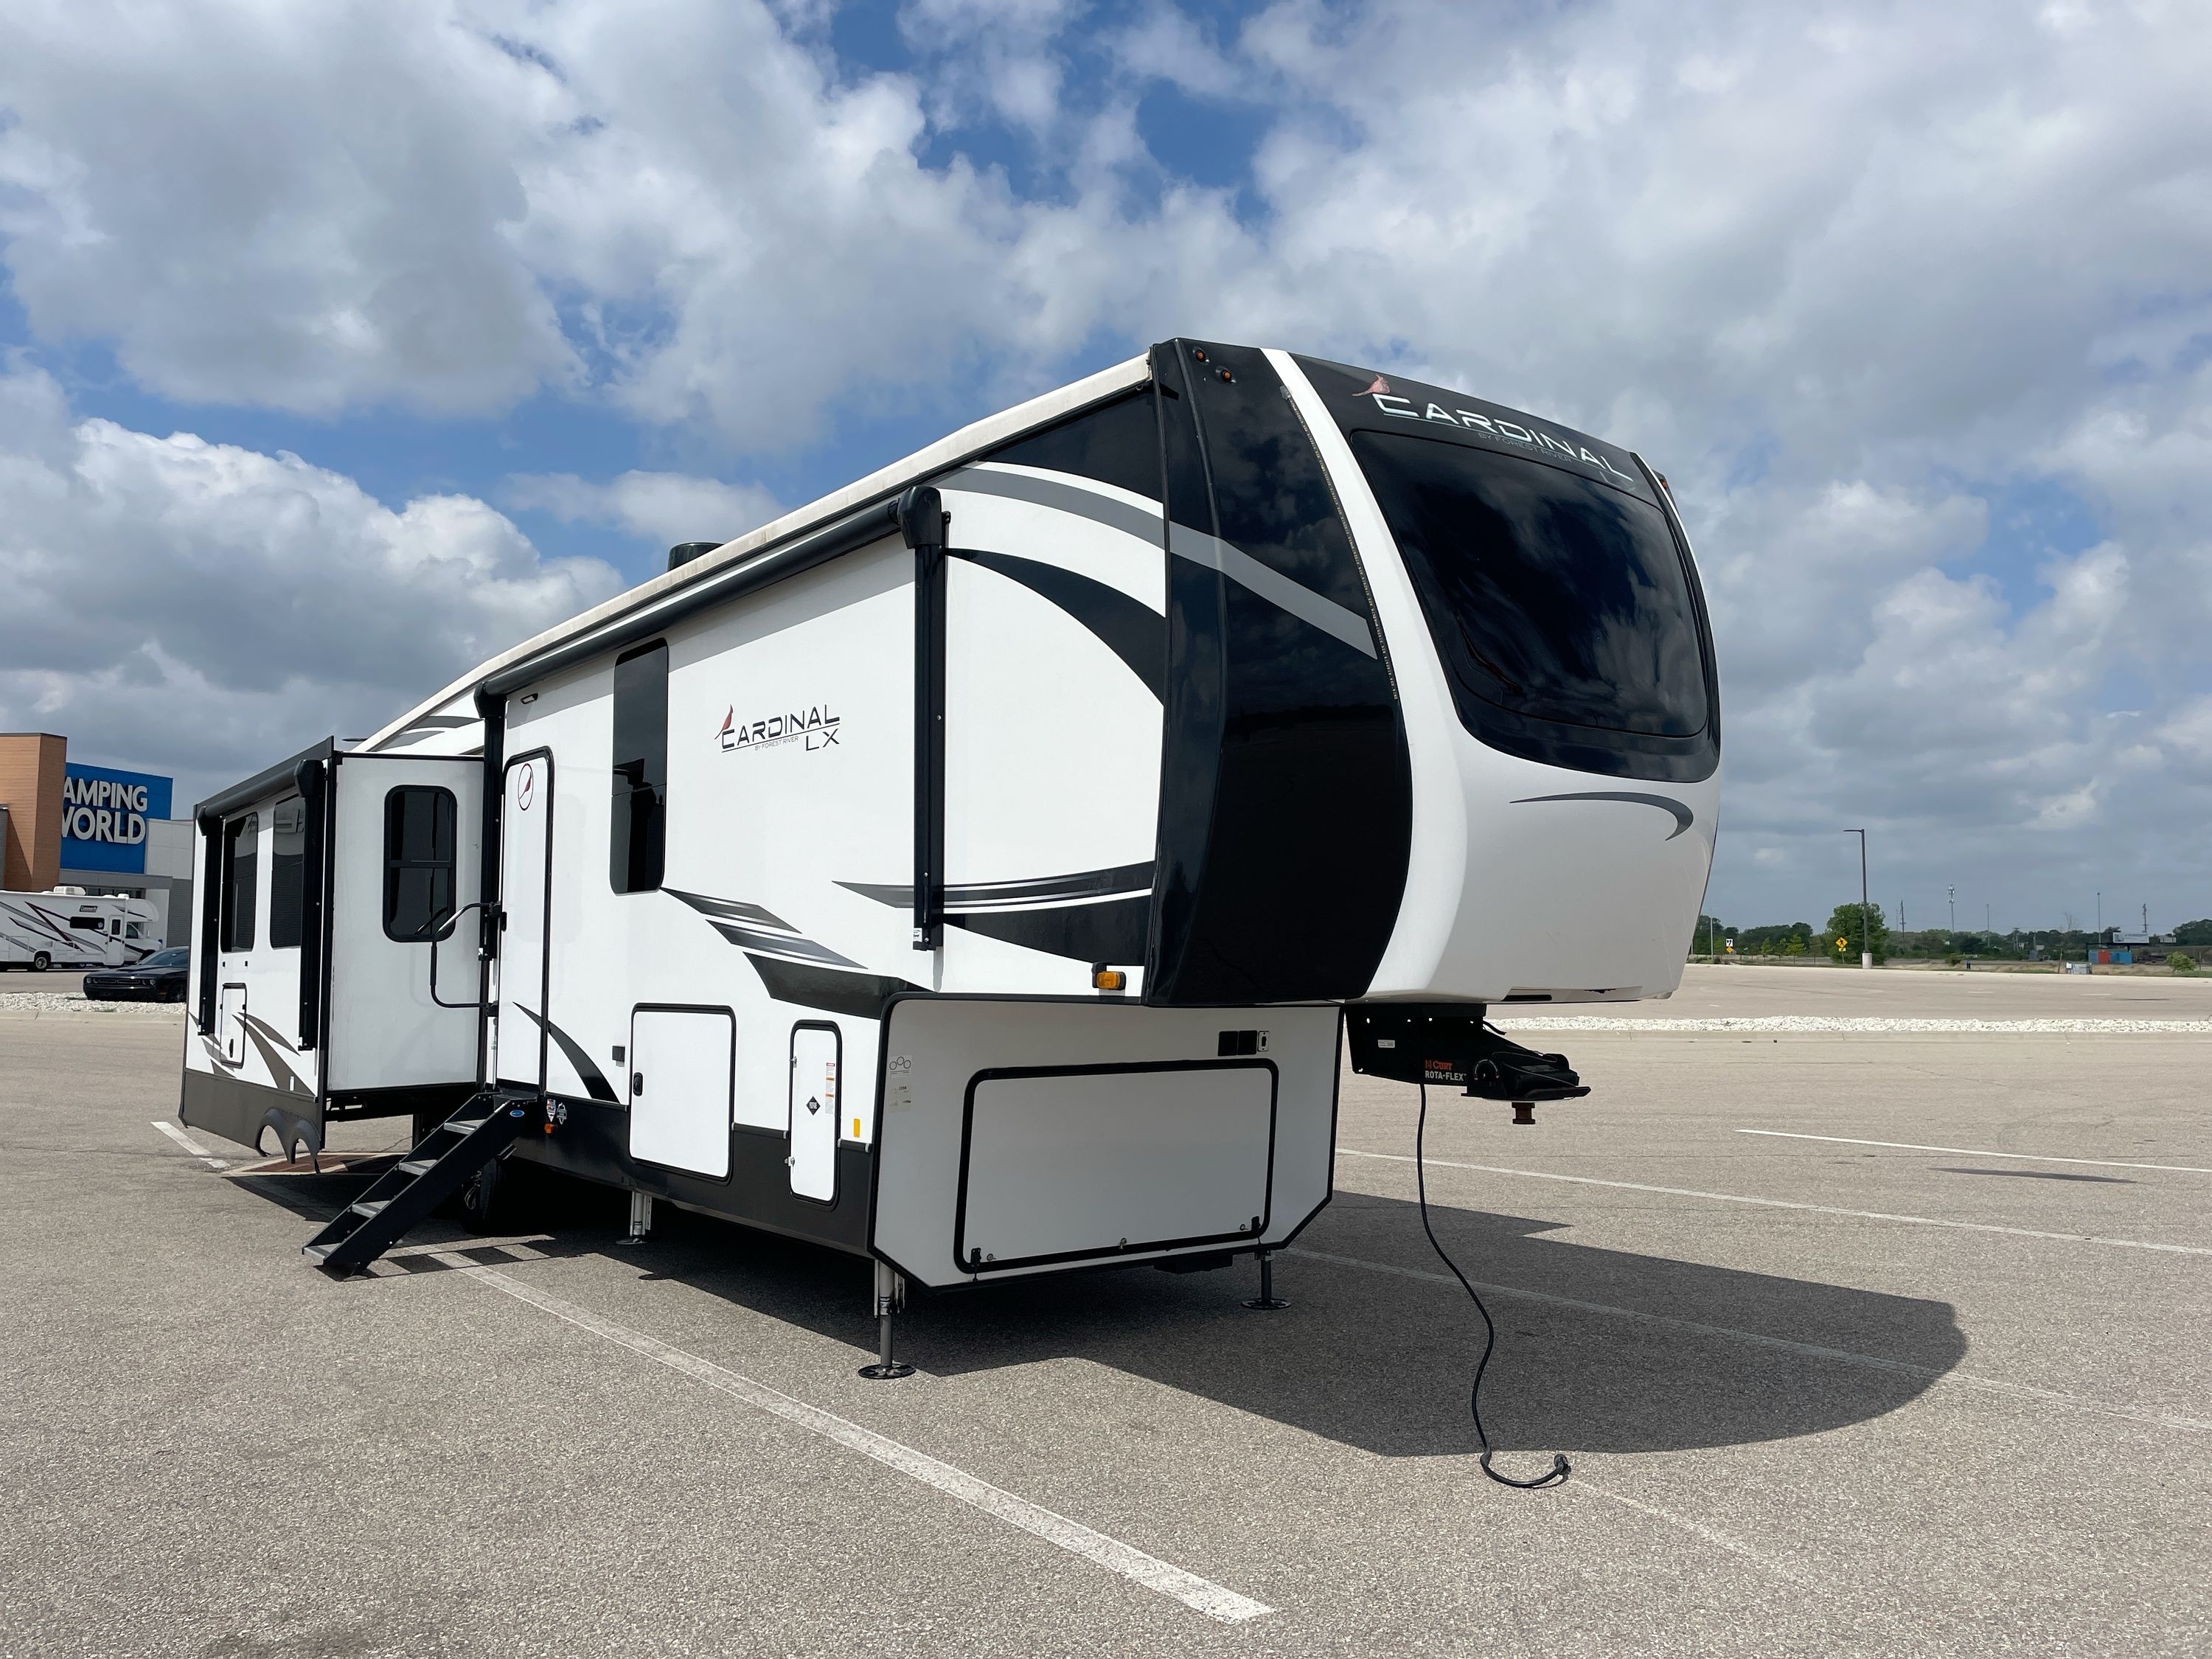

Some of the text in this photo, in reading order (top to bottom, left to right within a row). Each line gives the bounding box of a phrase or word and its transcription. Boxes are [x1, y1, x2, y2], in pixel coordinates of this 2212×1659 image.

[1372, 393, 1634, 482] CARDINAL
[1495, 436, 1538, 452] FOREST
[1540, 448, 1572, 463] RIVER
[722, 704, 840, 749] CARDINAL
[806, 728, 840, 751] LX
[762, 740, 782, 749] FOREST
[783, 736, 799, 744] RIVER
[63, 776, 147, 812] AMPING
